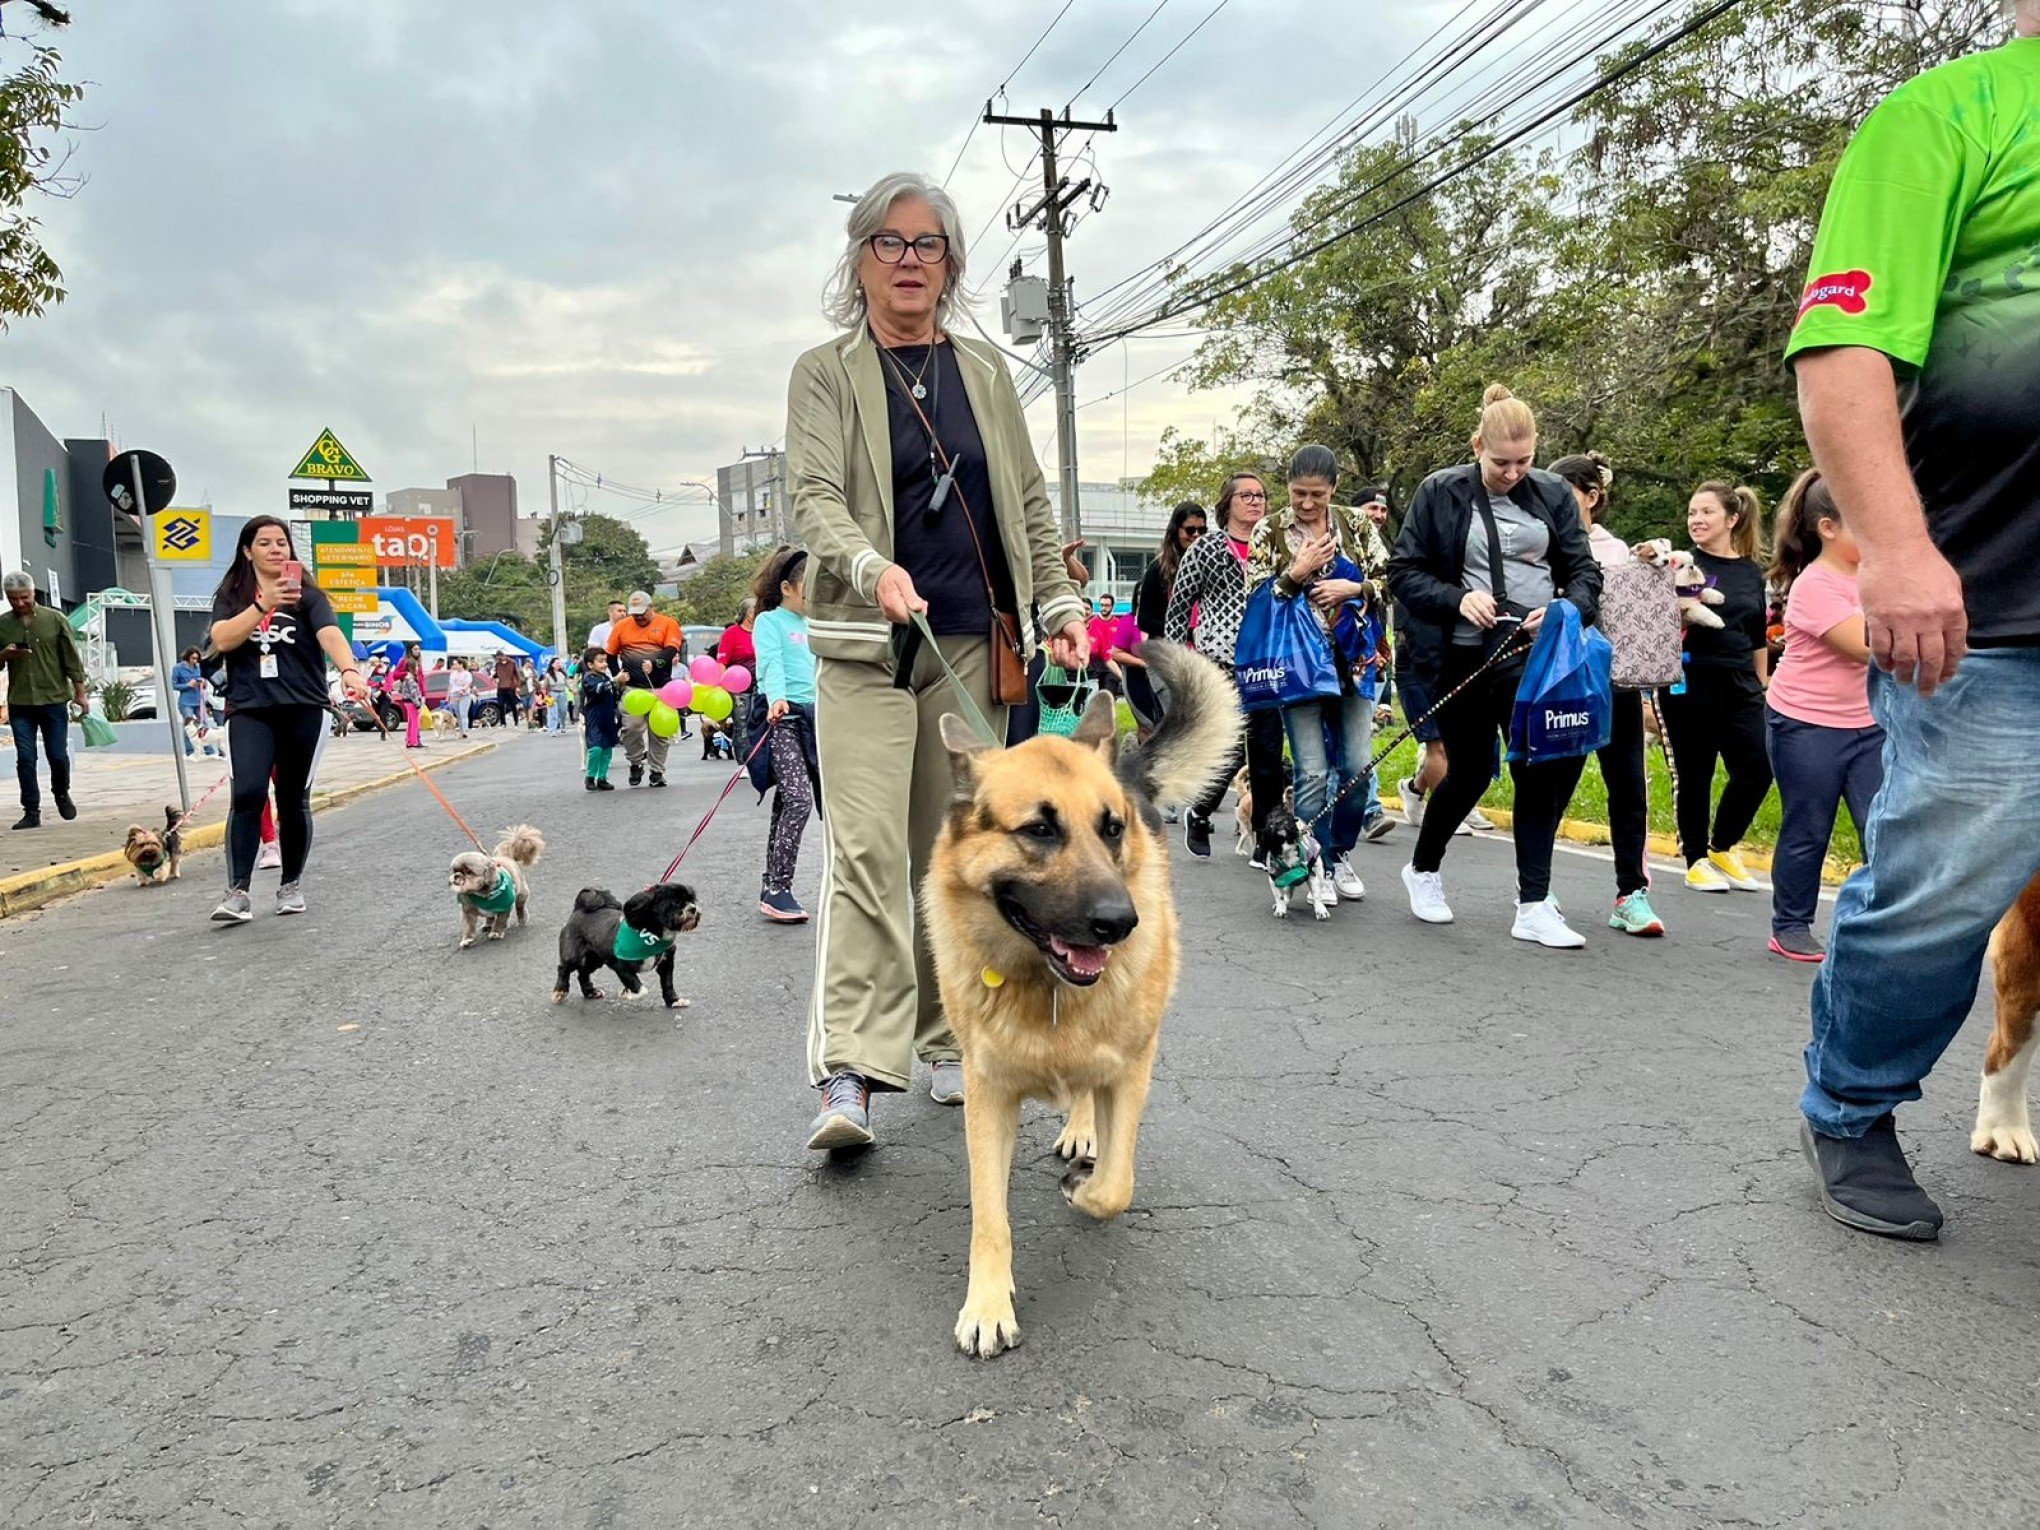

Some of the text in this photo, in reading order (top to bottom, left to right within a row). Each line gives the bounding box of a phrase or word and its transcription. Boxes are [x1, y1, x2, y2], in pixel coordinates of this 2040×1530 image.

[1802, 285, 1855, 306] ogard
[306, 463, 355, 476] BRAVO
[292, 494, 370, 506] SHOPPING VET
[384, 525, 405, 533] LOJAS
[1544, 709, 1591, 730] Primus
